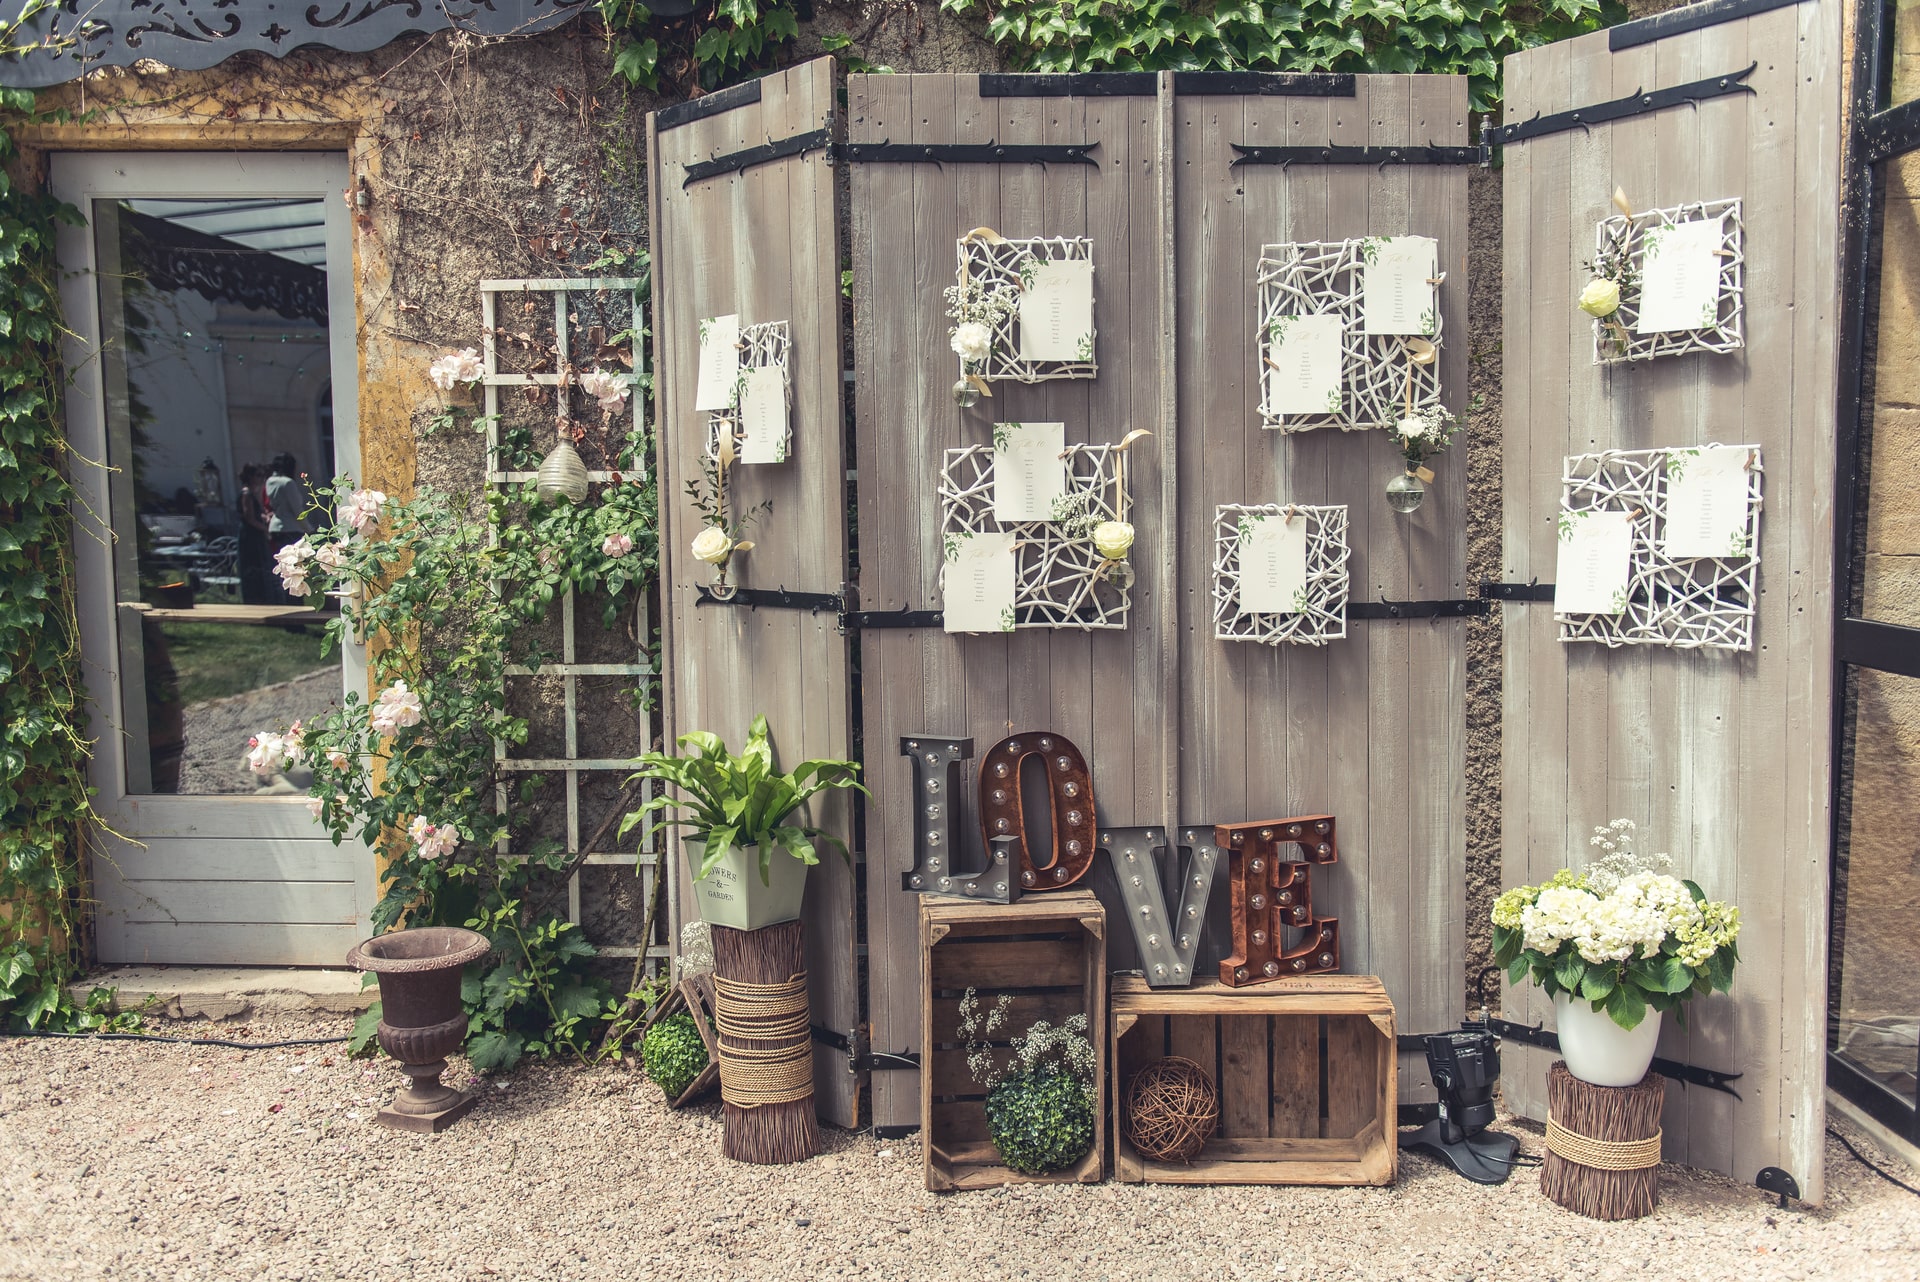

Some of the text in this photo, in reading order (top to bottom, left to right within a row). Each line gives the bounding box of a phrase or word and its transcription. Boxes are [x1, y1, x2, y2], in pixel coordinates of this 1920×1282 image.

[900, 731, 1340, 989] LOVE
[708, 866, 737, 882] OWERS
[707, 890, 734, 901] GARDEN
